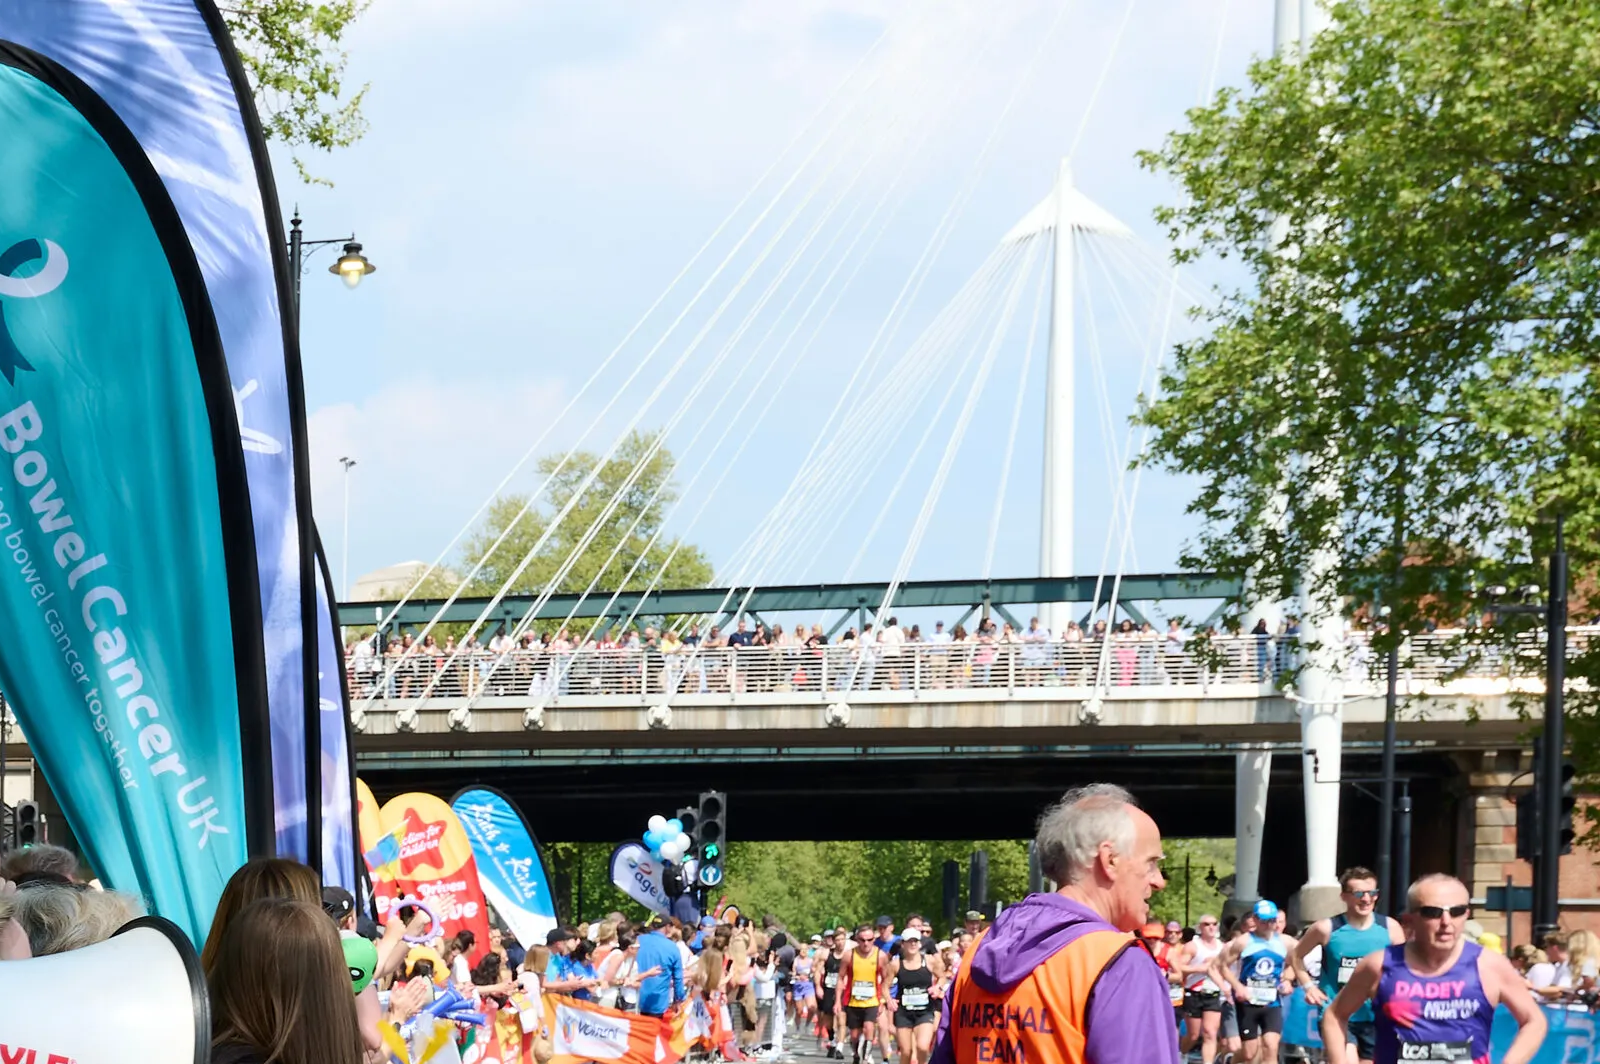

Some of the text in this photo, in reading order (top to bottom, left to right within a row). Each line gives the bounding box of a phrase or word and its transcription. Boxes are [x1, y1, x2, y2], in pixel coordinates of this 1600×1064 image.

[5, 528, 54, 606] bowel
[44, 608, 90, 684] cancer
[84, 687, 139, 790] together
[82, 585, 187, 777] Cancer
[176, 775, 229, 850] UK
[634, 871, 659, 897] age
[1394, 981, 1465, 999] DADEY
[960, 1002, 1054, 1034] MARSHAL
[973, 1036, 1025, 1064] TEAM
